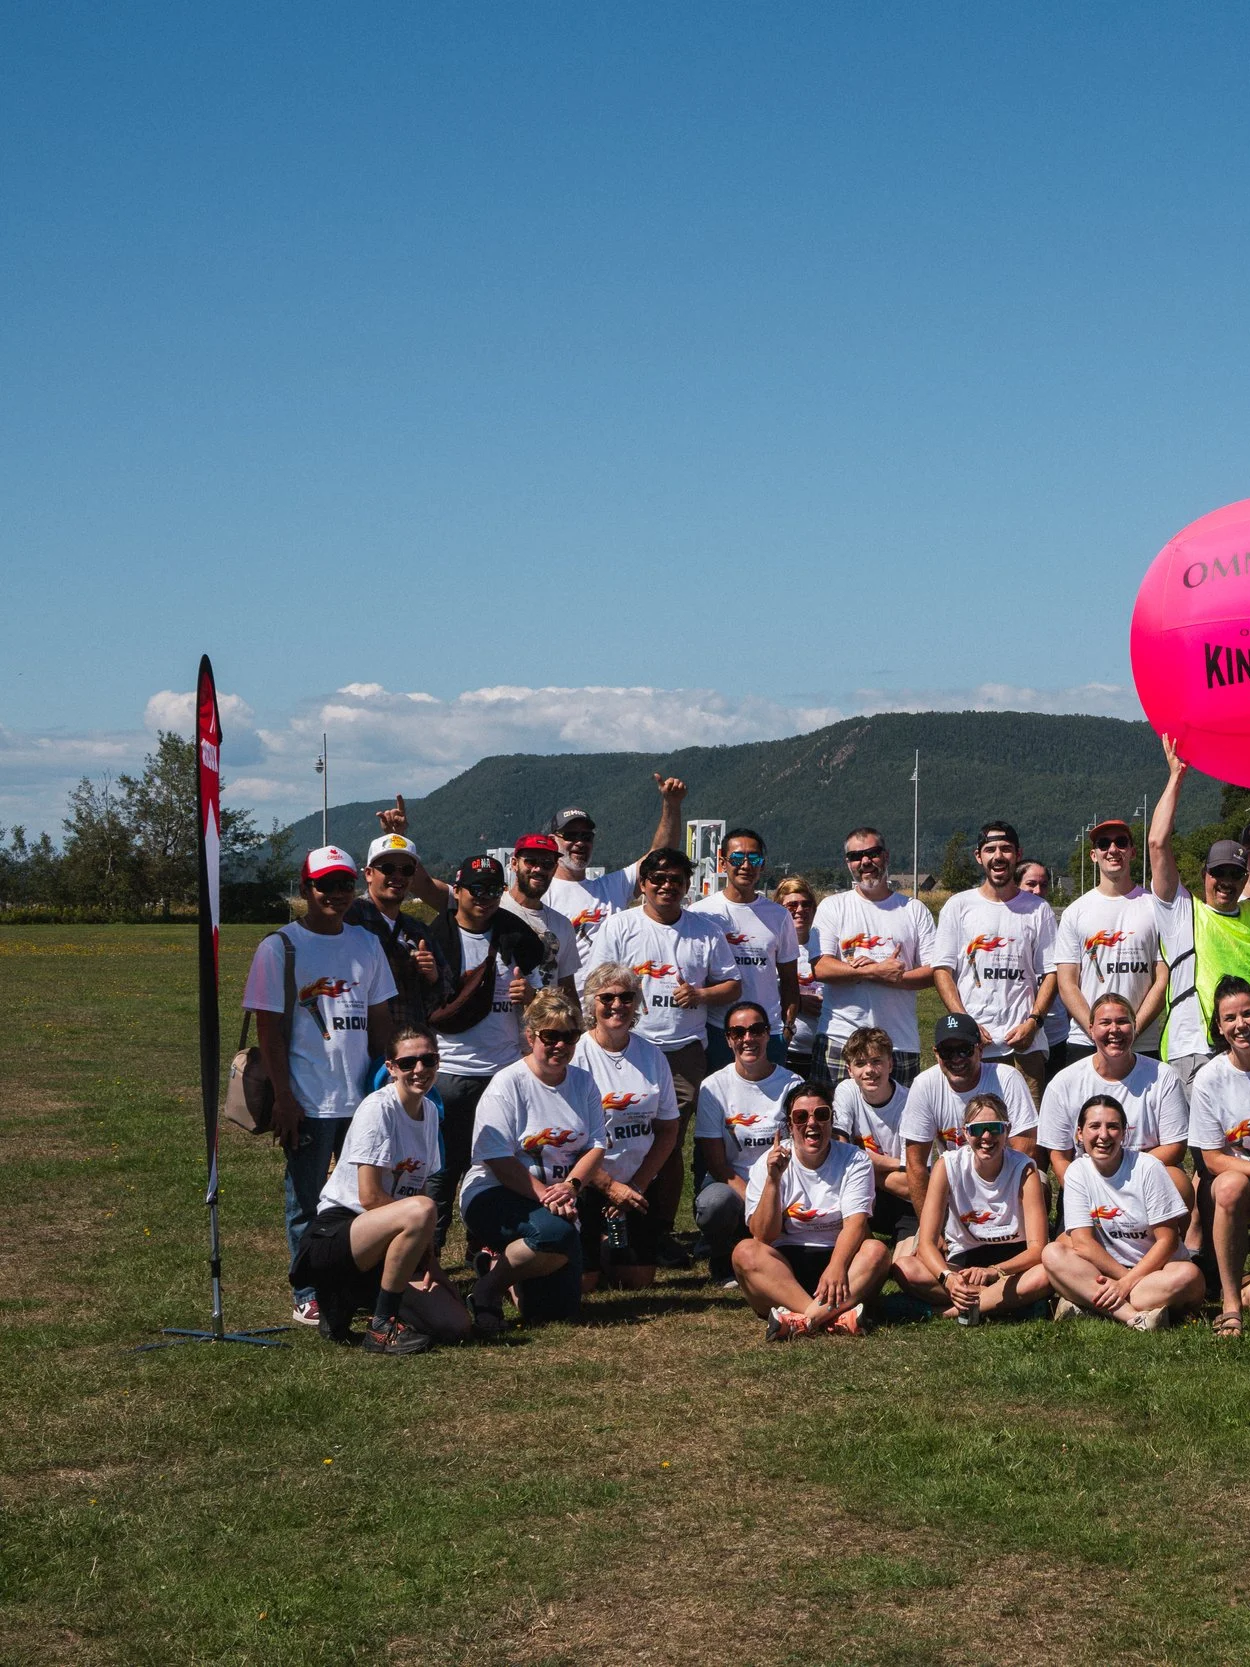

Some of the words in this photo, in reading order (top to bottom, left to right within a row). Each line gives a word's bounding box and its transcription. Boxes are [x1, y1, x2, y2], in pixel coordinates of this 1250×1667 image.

[984, 968, 1026, 980] RIOUX
[1107, 962, 1149, 974] RIOUX
[333, 1016, 368, 1030] RIOU
[947, 1016, 959, 1028] LA
[615, 1124, 654, 1139] RIOU
[744, 1137, 783, 1147] RIOU
[1109, 1230, 1148, 1239] RIOUX
